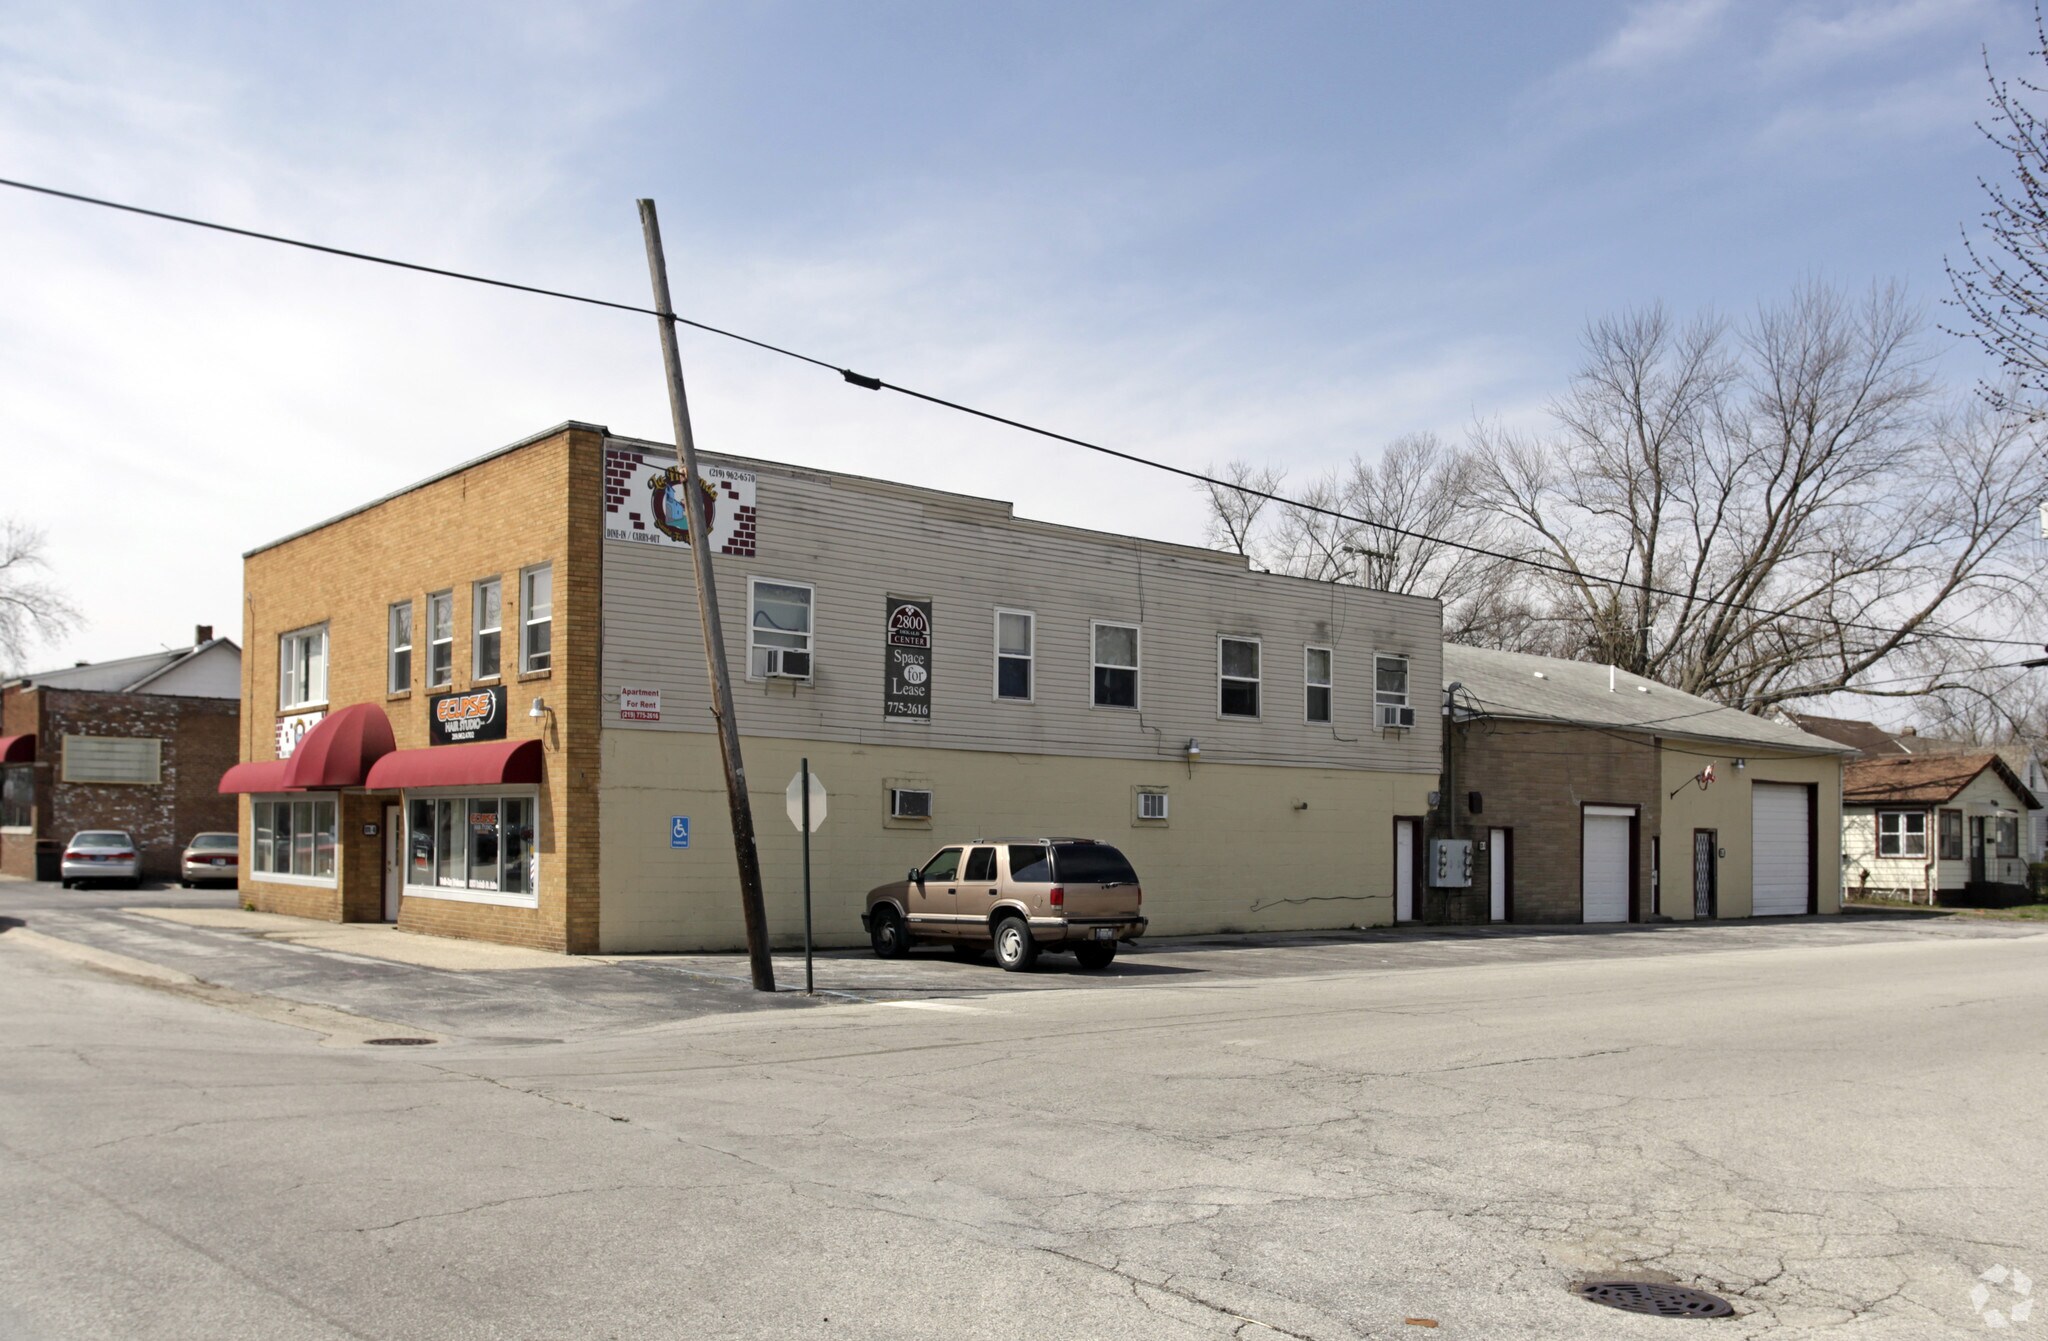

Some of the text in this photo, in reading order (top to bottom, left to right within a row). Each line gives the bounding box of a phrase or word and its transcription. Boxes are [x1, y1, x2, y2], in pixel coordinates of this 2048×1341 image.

[606, 528, 626, 540] DINE-IN
[632, 532, 660, 543] CARRY-OUT
[896, 615, 923, 629] 2800
[894, 635, 925, 645] CENTER
[894, 649, 924, 666] Space
[908, 667, 924, 682] for
[622, 688, 659, 696] Apartment
[892, 677, 925, 696] Lease
[626, 700, 656, 709] For Rent
[887, 701, 928, 715] 775-2616
[445, 718, 481, 733] HAIR STUDIO
